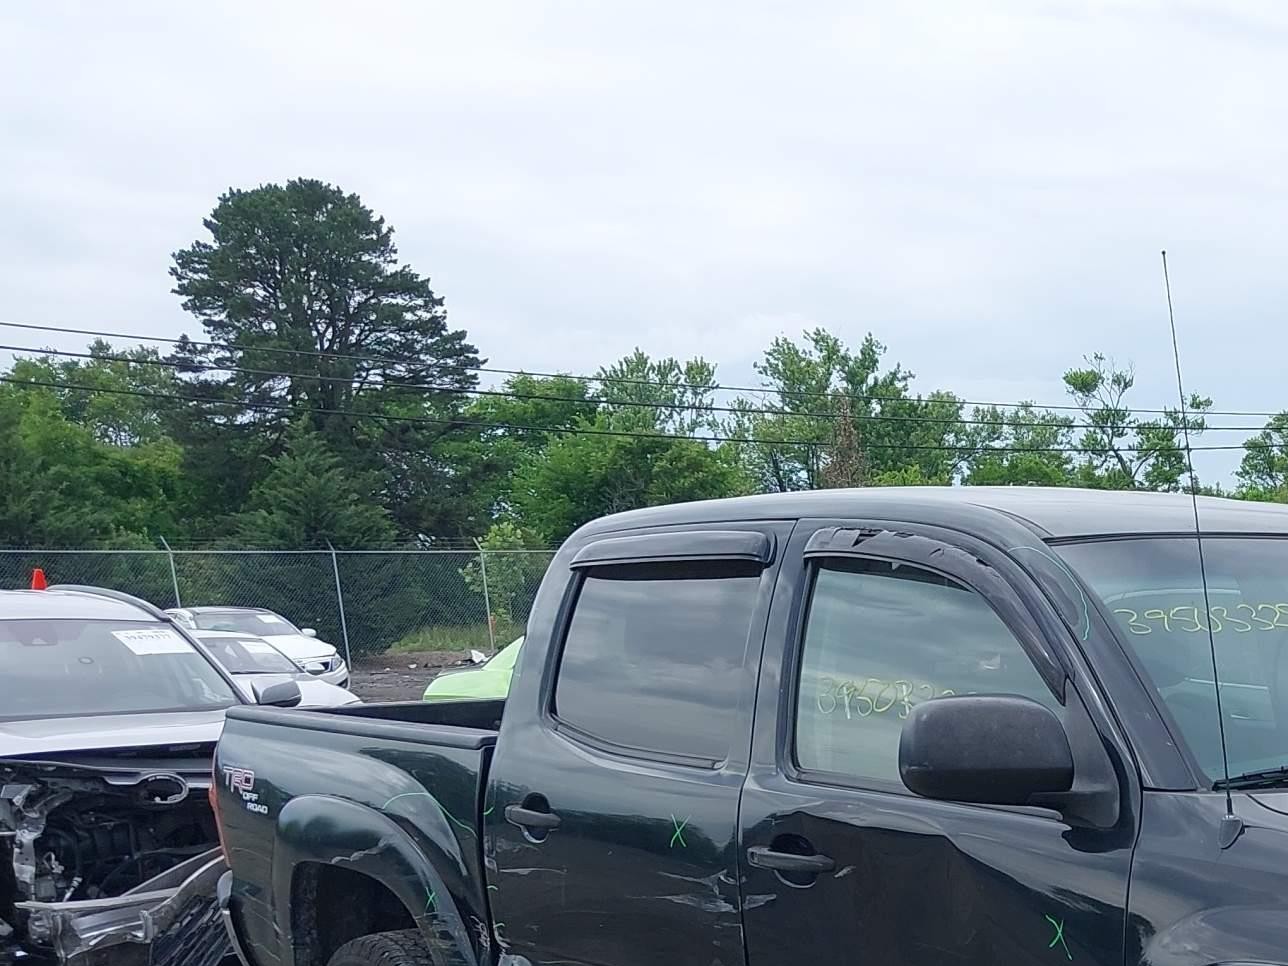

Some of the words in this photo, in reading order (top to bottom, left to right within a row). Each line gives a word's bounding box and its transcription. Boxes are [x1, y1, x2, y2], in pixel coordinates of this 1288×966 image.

[817, 676, 978, 720] 39503
[223, 765, 255, 794] TRD
[242, 791, 259, 801] OFF
[247, 802, 269, 814] ROAD
